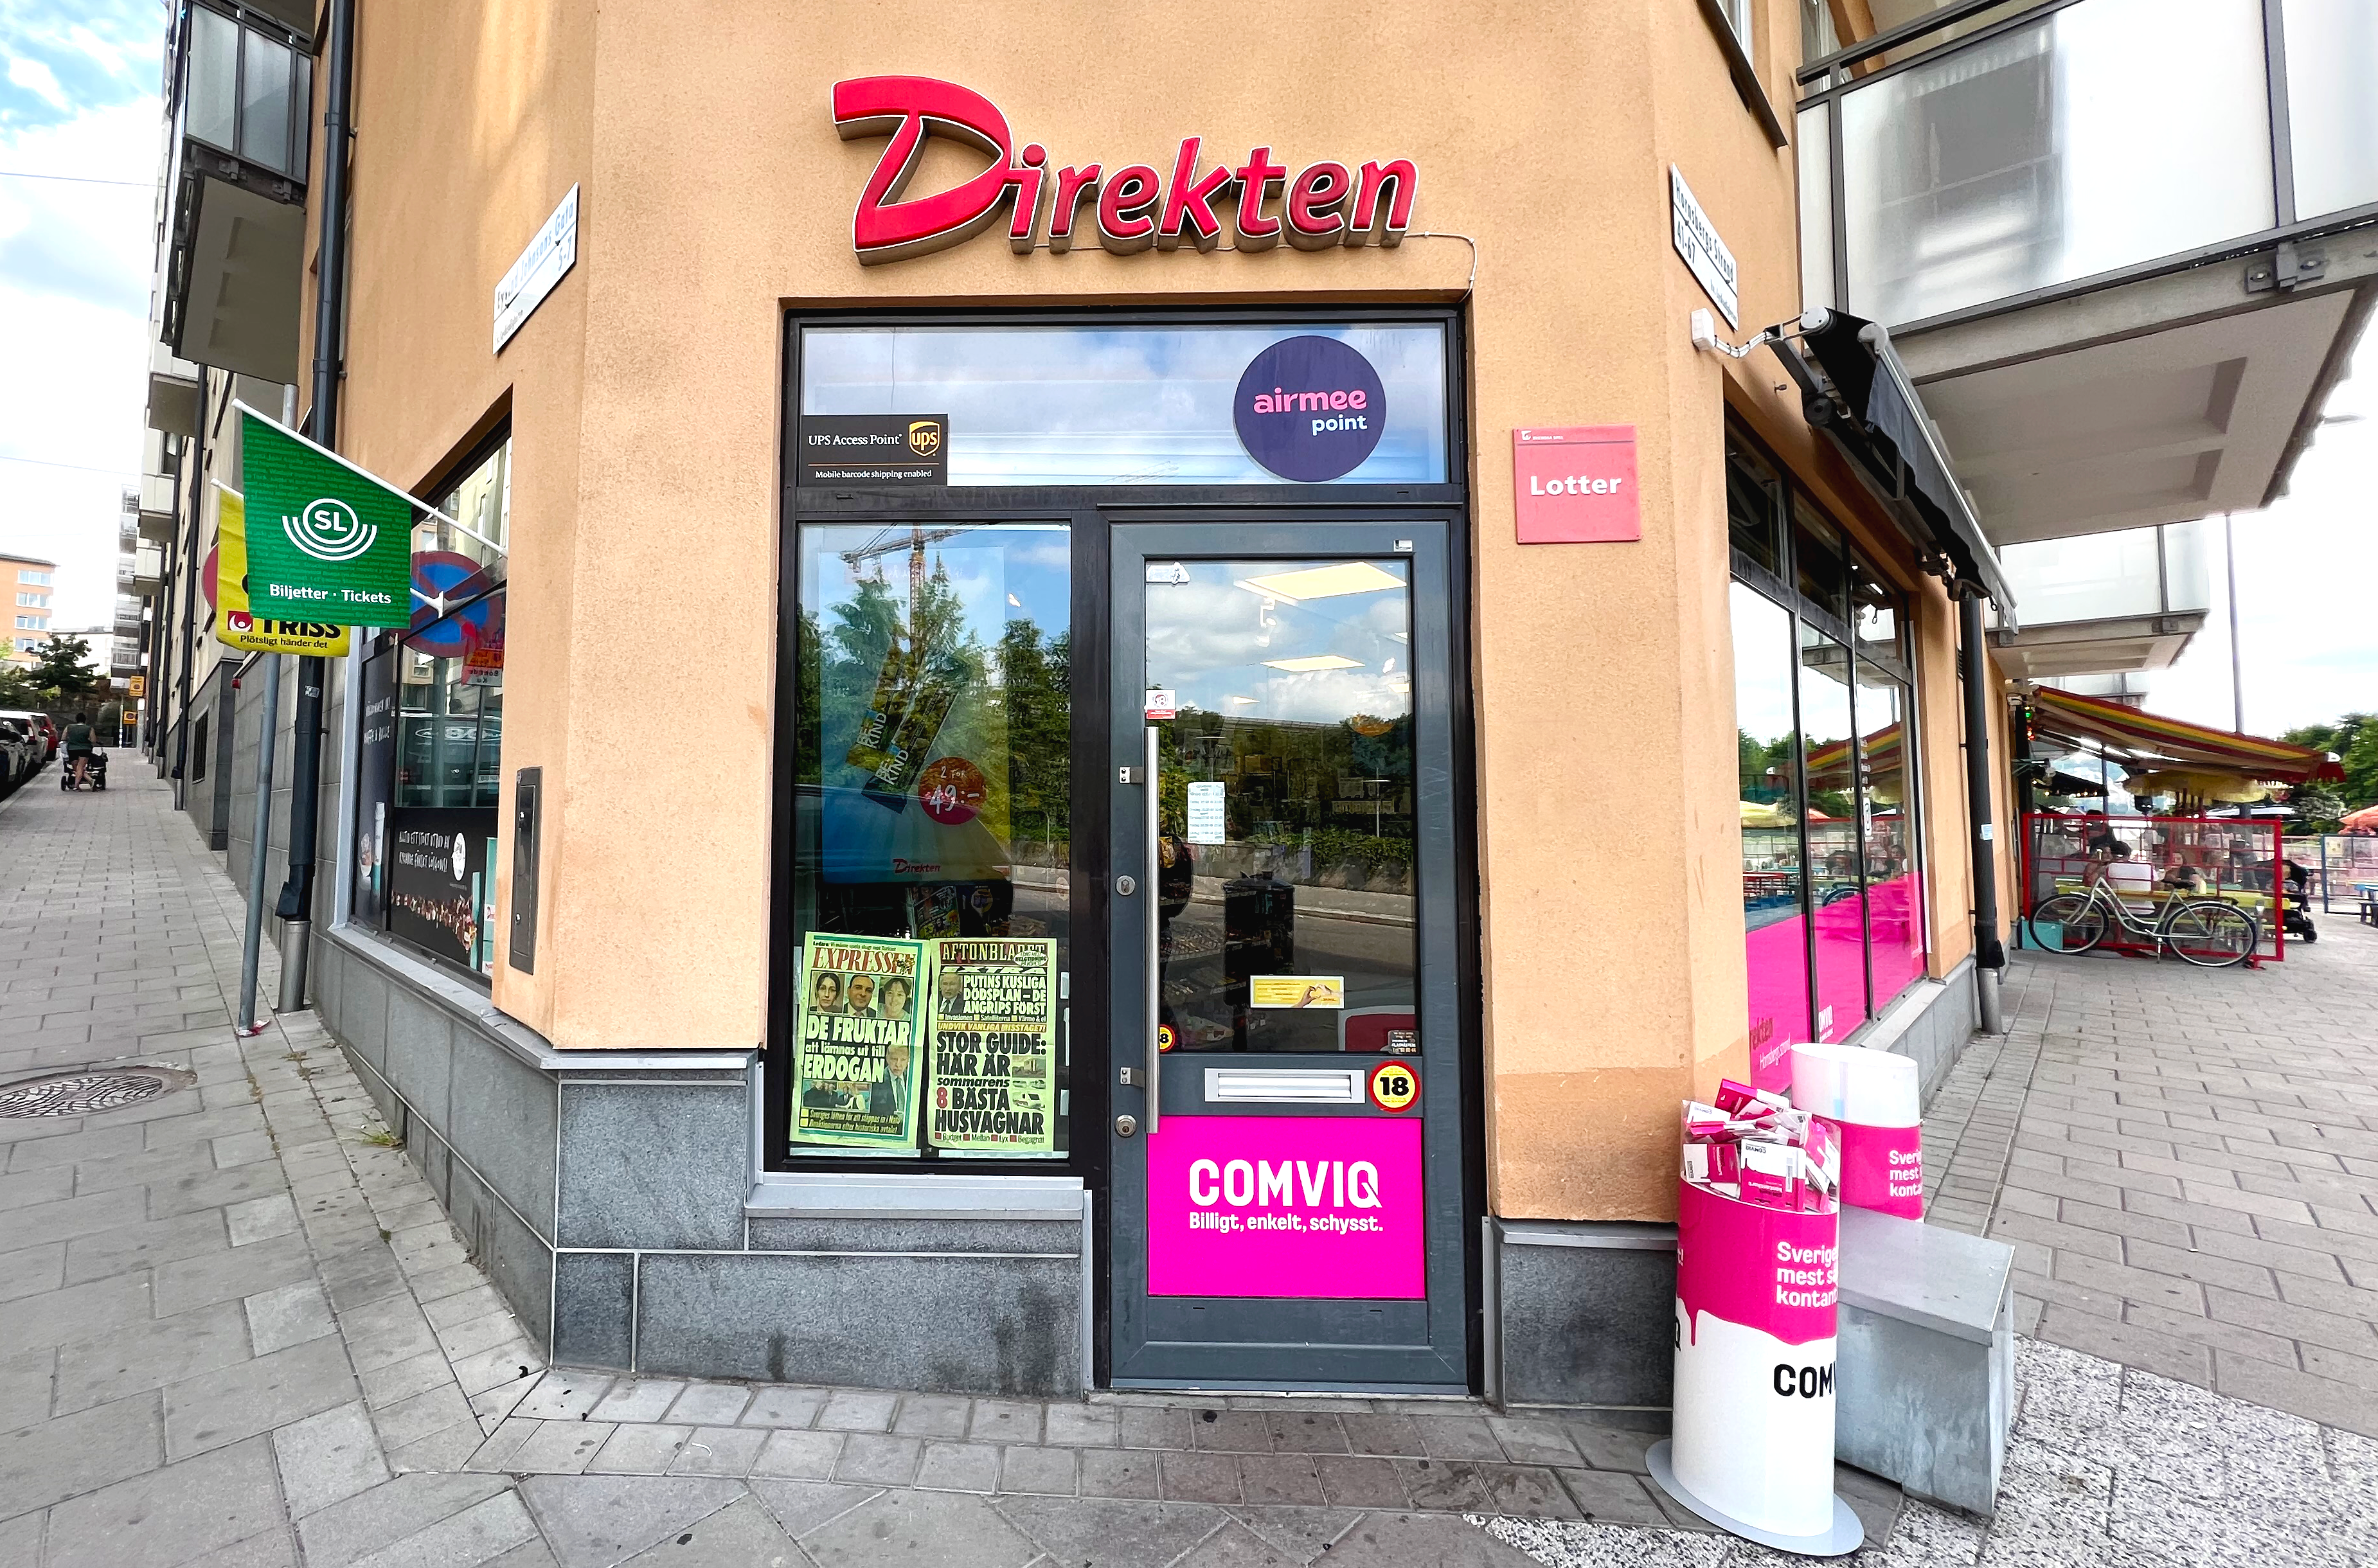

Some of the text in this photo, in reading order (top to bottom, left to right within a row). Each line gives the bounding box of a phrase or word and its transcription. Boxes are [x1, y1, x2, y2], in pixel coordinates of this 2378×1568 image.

[832, 75, 1418, 257] Direkten
[1676, 176, 1712, 253] Hornsbergs
[1714, 238, 1734, 283] Strand
[520, 229, 552, 283] Johnsons
[554, 201, 574, 236] Gata
[1677, 220, 1696, 264] 41-67
[558, 235, 573, 272] 5-7
[1253, 388, 1367, 414] airmee
[1312, 414, 1368, 436] point
[808, 433, 900, 445] UPS Access Point
[911, 431, 938, 451] ups
[815, 469, 933, 479] Mobile barcode shipping enabled
[1530, 475, 1622, 495] Lotter
[314, 510, 348, 532] SL
[269, 584, 391, 604] Biljetter Tickets
[240, 634, 328, 648] Plötsligt händer det
[865, 713, 888, 750] KIND
[885, 750, 909, 785] KIND
[940, 765, 947, 778] 2
[893, 858, 940, 873] Direkten
[812, 947, 916, 975] EXPRESSEN
[942, 966, 1046, 974] EXTRA
[965, 975, 1046, 989] PUTINS KUSLIGA
[963, 988, 1022, 1001] DÖDSPLAN
[1033, 990, 1046, 1002] DE
[963, 1001, 1046, 1015] ANGRIPS FÖRST
[807, 1015, 909, 1046] DE FRUKTAR
[968, 1023, 1001, 1031] VANLIGA
[805, 1041, 885, 1057] att lämnas ut till
[936, 1031, 1046, 1055] STOR GUIDE:
[803, 1054, 885, 1083] ERDOGAN
[936, 1053, 1010, 1076] HÄR ÄR
[937, 1077, 1010, 1087] sommarens
[1379, 1076, 1409, 1096] 18
[936, 1087, 1010, 1110] 8 BÄSTA
[935, 1109, 1044, 1135] HUSVAGNAR
[943, 1134, 961, 1142] Budget
[999, 1135, 1008, 1144] Lyx
[1018, 1135, 1045, 1145] Begagnat
[1188, 1158, 1383, 1209] COMVIQ
[1890, 1167, 1919, 1180] mest
[1189, 1211, 1384, 1235] Billigt, enkelt, schysst.
[1777, 1268, 1825, 1286] mest
[1773, 1360, 1837, 1399] COM
